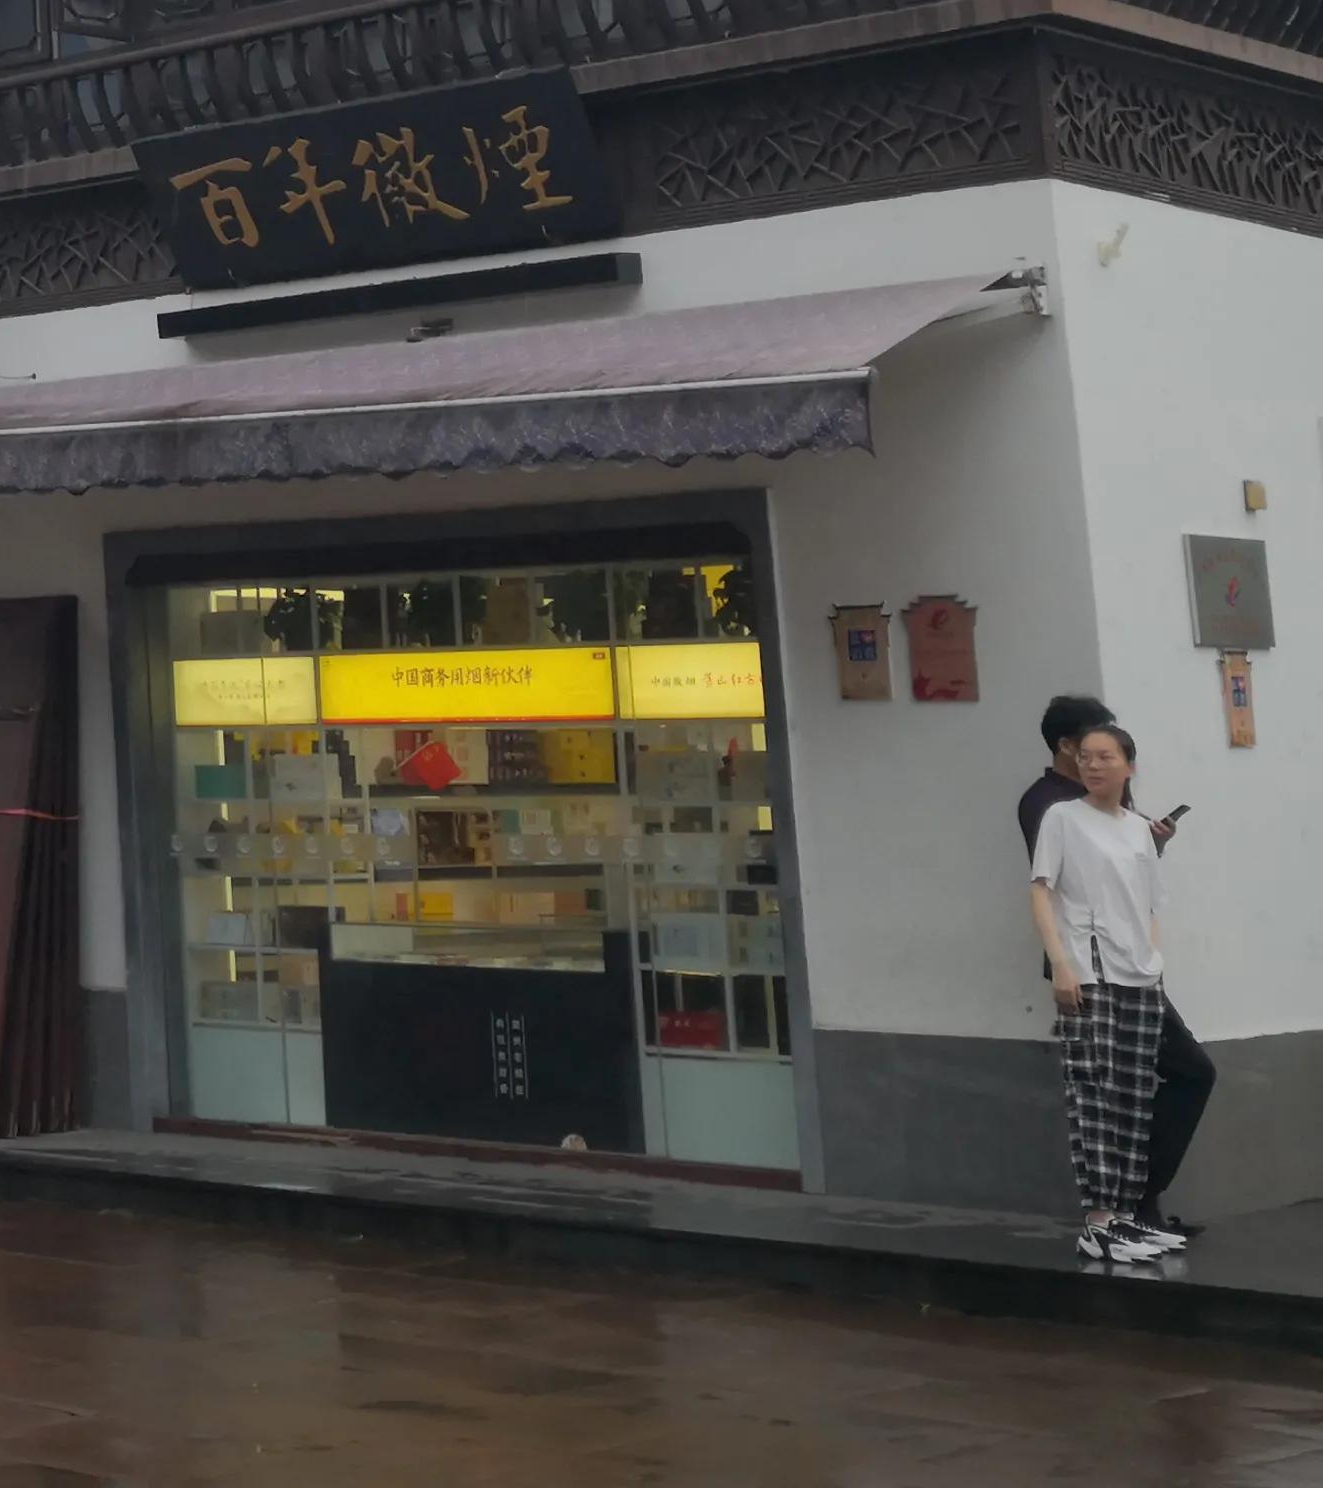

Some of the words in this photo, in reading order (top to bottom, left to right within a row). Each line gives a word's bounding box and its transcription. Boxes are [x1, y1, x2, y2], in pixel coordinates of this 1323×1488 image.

[391, 665, 533, 688] 中国商务用烟新伙伴
